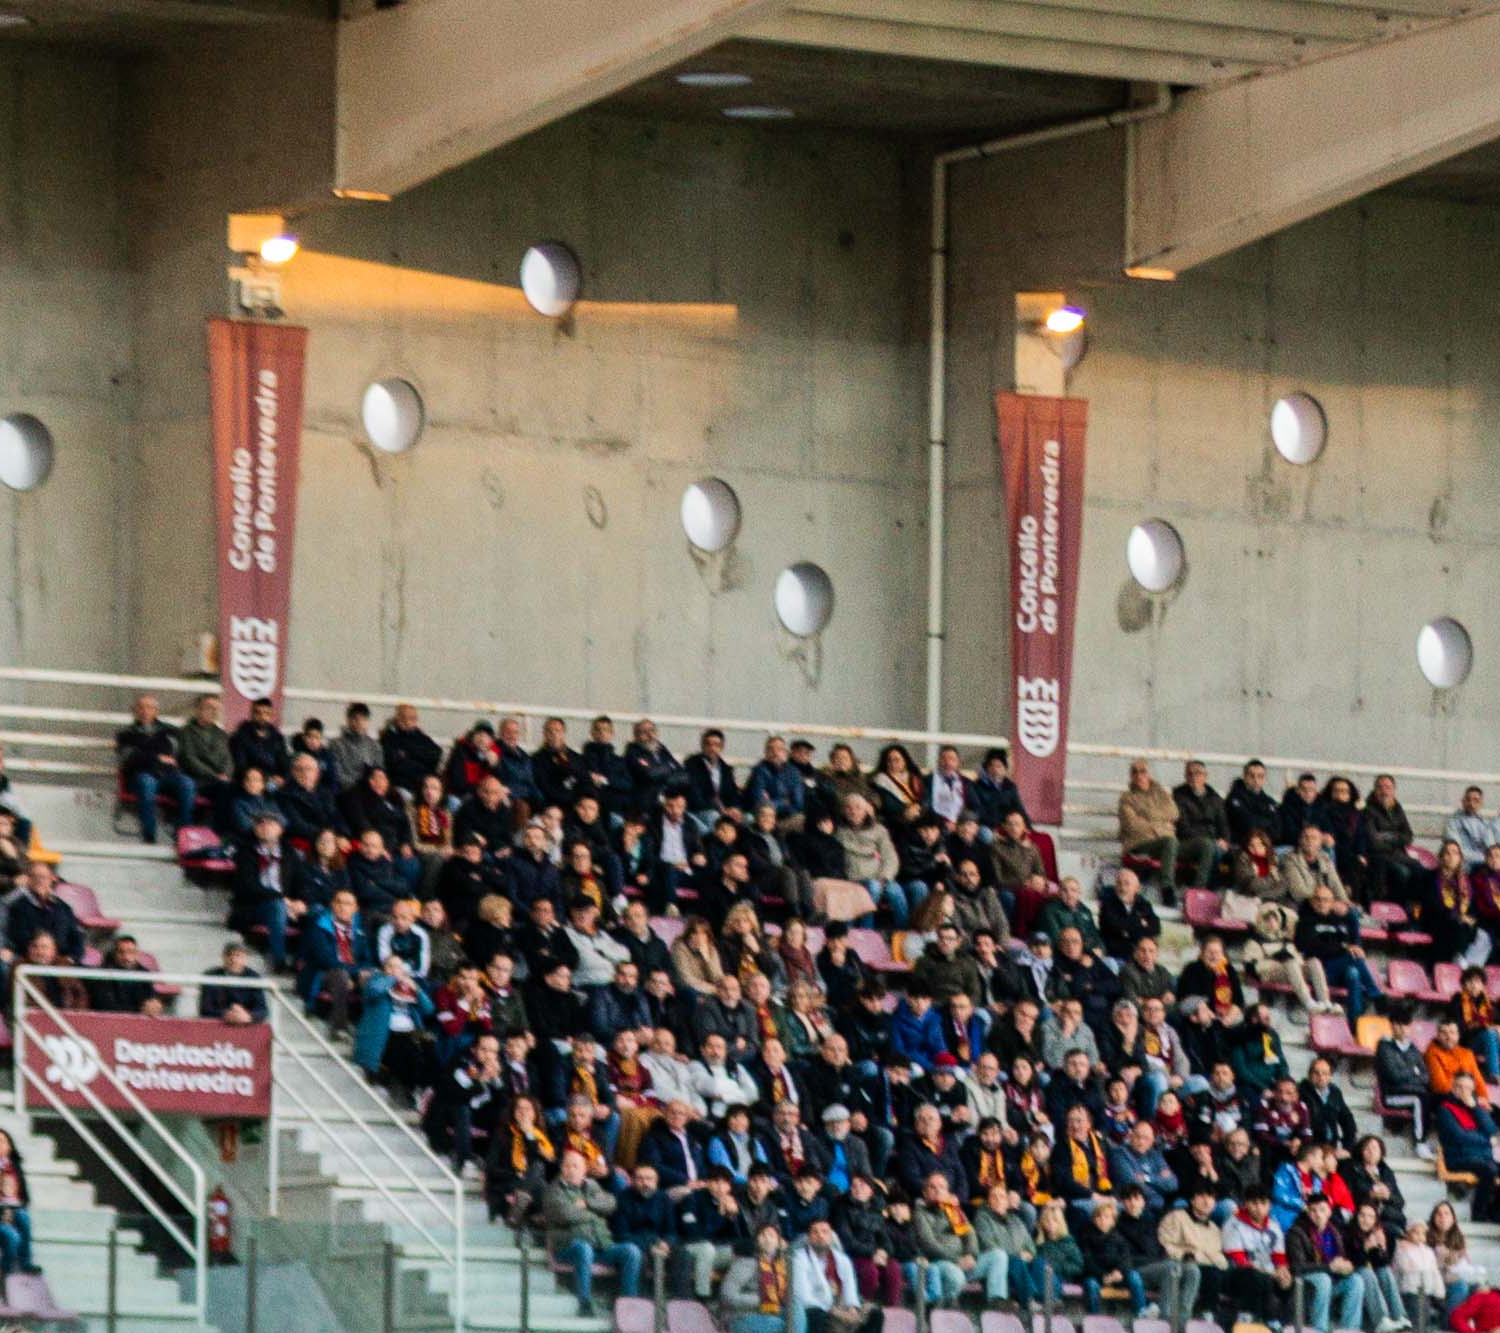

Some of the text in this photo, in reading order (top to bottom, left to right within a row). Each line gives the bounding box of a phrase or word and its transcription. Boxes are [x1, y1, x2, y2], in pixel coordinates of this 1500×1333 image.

[228, 448, 253, 571] Concello
[254, 369, 279, 573] de Pontevedra
[1017, 515, 1038, 633] Concello
[1040, 440, 1061, 634] de Pontevedra
[114, 1038, 254, 1070] Deputación
[114, 1066, 254, 1097] Pontevedra
